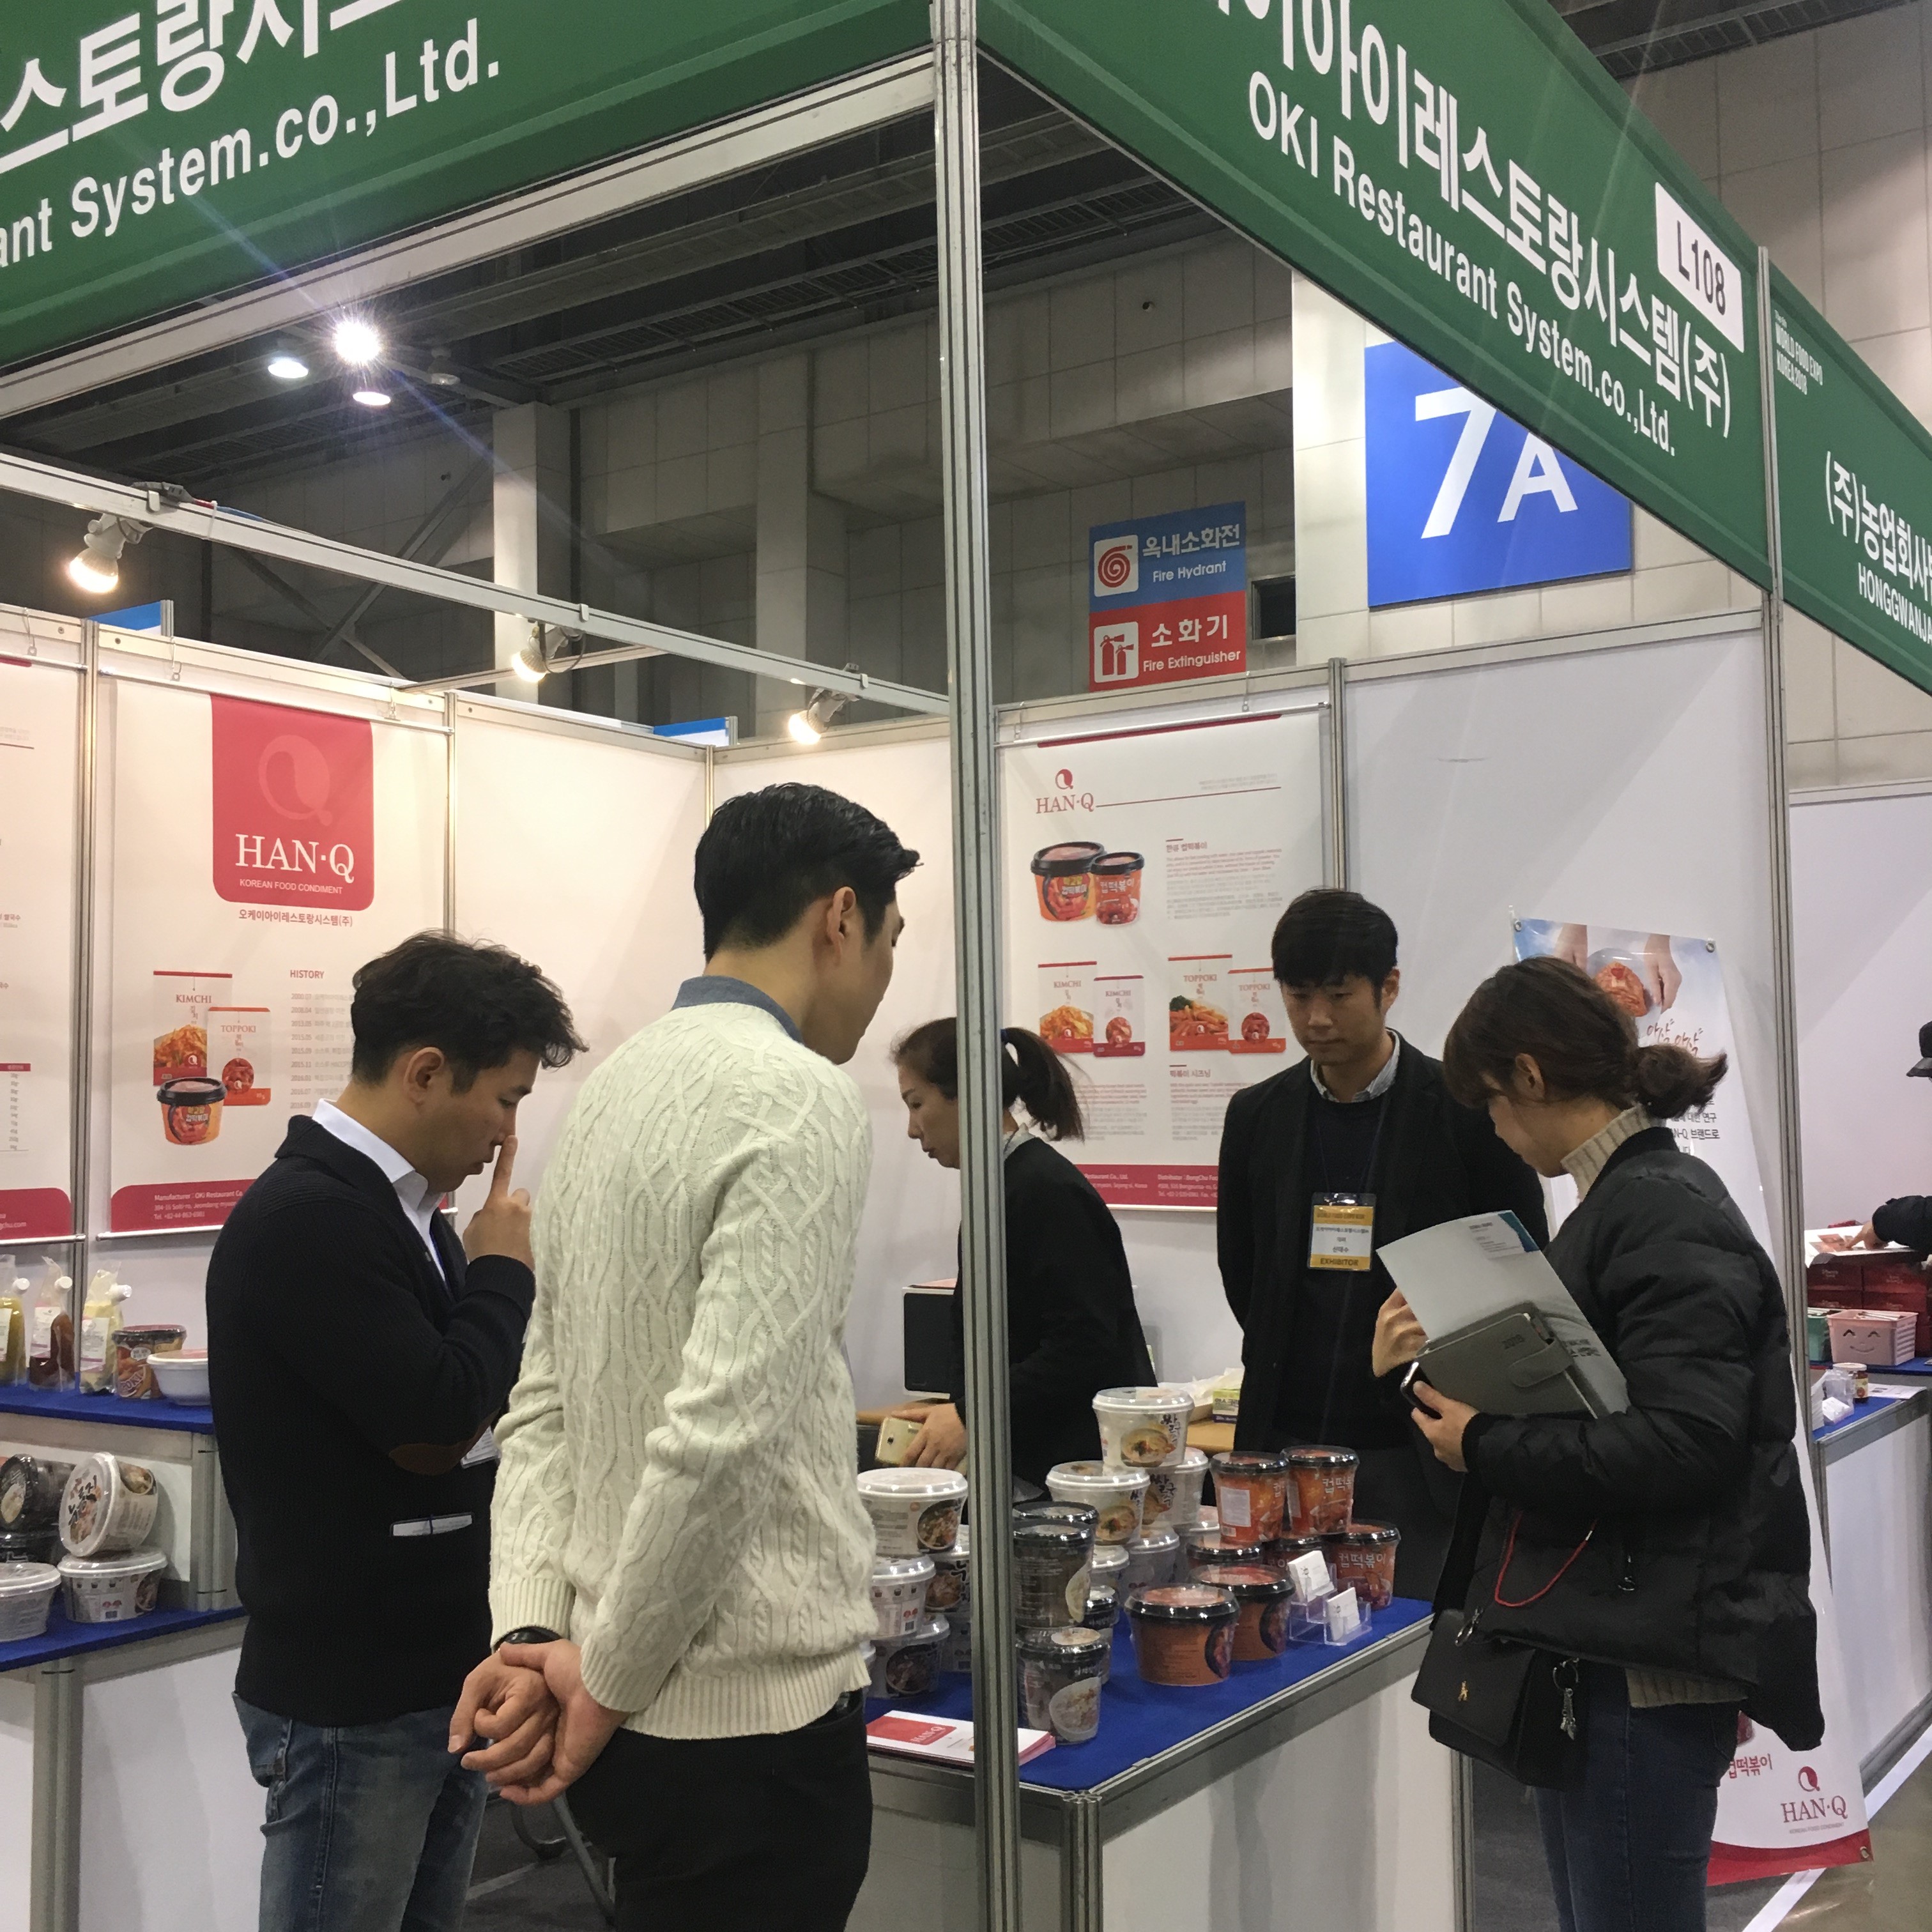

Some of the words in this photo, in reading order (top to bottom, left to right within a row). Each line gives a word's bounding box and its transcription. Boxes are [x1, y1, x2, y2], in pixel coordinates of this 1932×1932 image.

[1249, 71, 1317, 178] OKI
[1334, 135, 1498, 319] Restaurant
[1677, 220, 1726, 316] L108
[1142, 523, 1241, 558] 옥내소화전
[1153, 570, 1174, 583] Fire
[1177, 560, 1227, 579] Hydrant
[1143, 659, 1164, 672] Fire
[1168, 650, 1241, 670] Extinguisher
[240, 878, 273, 889] KOREAN
[274, 881, 296, 891] FOOD
[298, 884, 343, 895] CONDIMENT
[239, 908, 353, 928] 오케이아이레스토랑시스템(주)
[290, 970, 325, 979] HISTORY
[1183, 974, 1217, 982] TOPPOKI
[1054, 980, 1082, 988] KIMCHI
[176, 994, 212, 1003] KIMCHI
[220, 1025, 257, 1033] TOPPOKI
[1702, 1112, 1717, 1123] 연구
[1690, 1128, 1721, 1140] 브랜드로
[1320, 1257, 1360, 1266] EXHIBITOR
[1338, 1552, 1386, 1569] 컵떡볶이
